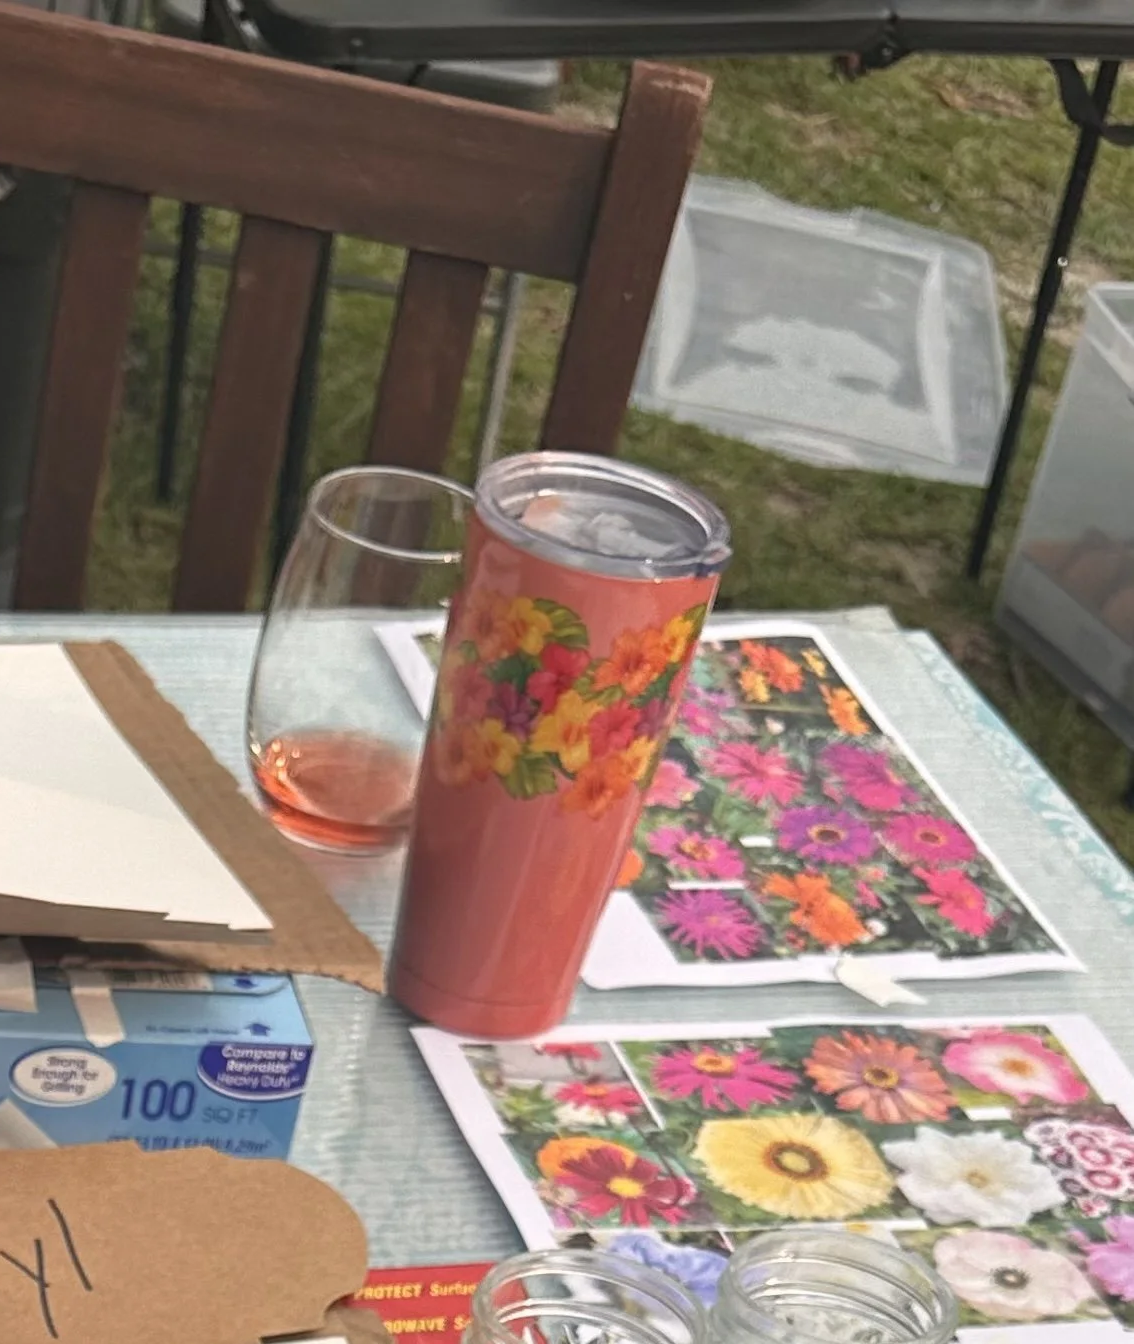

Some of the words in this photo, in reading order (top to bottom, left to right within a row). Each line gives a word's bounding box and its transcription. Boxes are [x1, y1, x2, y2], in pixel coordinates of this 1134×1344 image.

[221, 1044, 288, 1061] Compare
[47, 1056, 88, 1070] Strong
[31, 1066, 77, 1081] Enough
[121, 1077, 198, 1123] 100
[201, 1108, 232, 1124] SQ
[235, 1108, 259, 1126] FT
